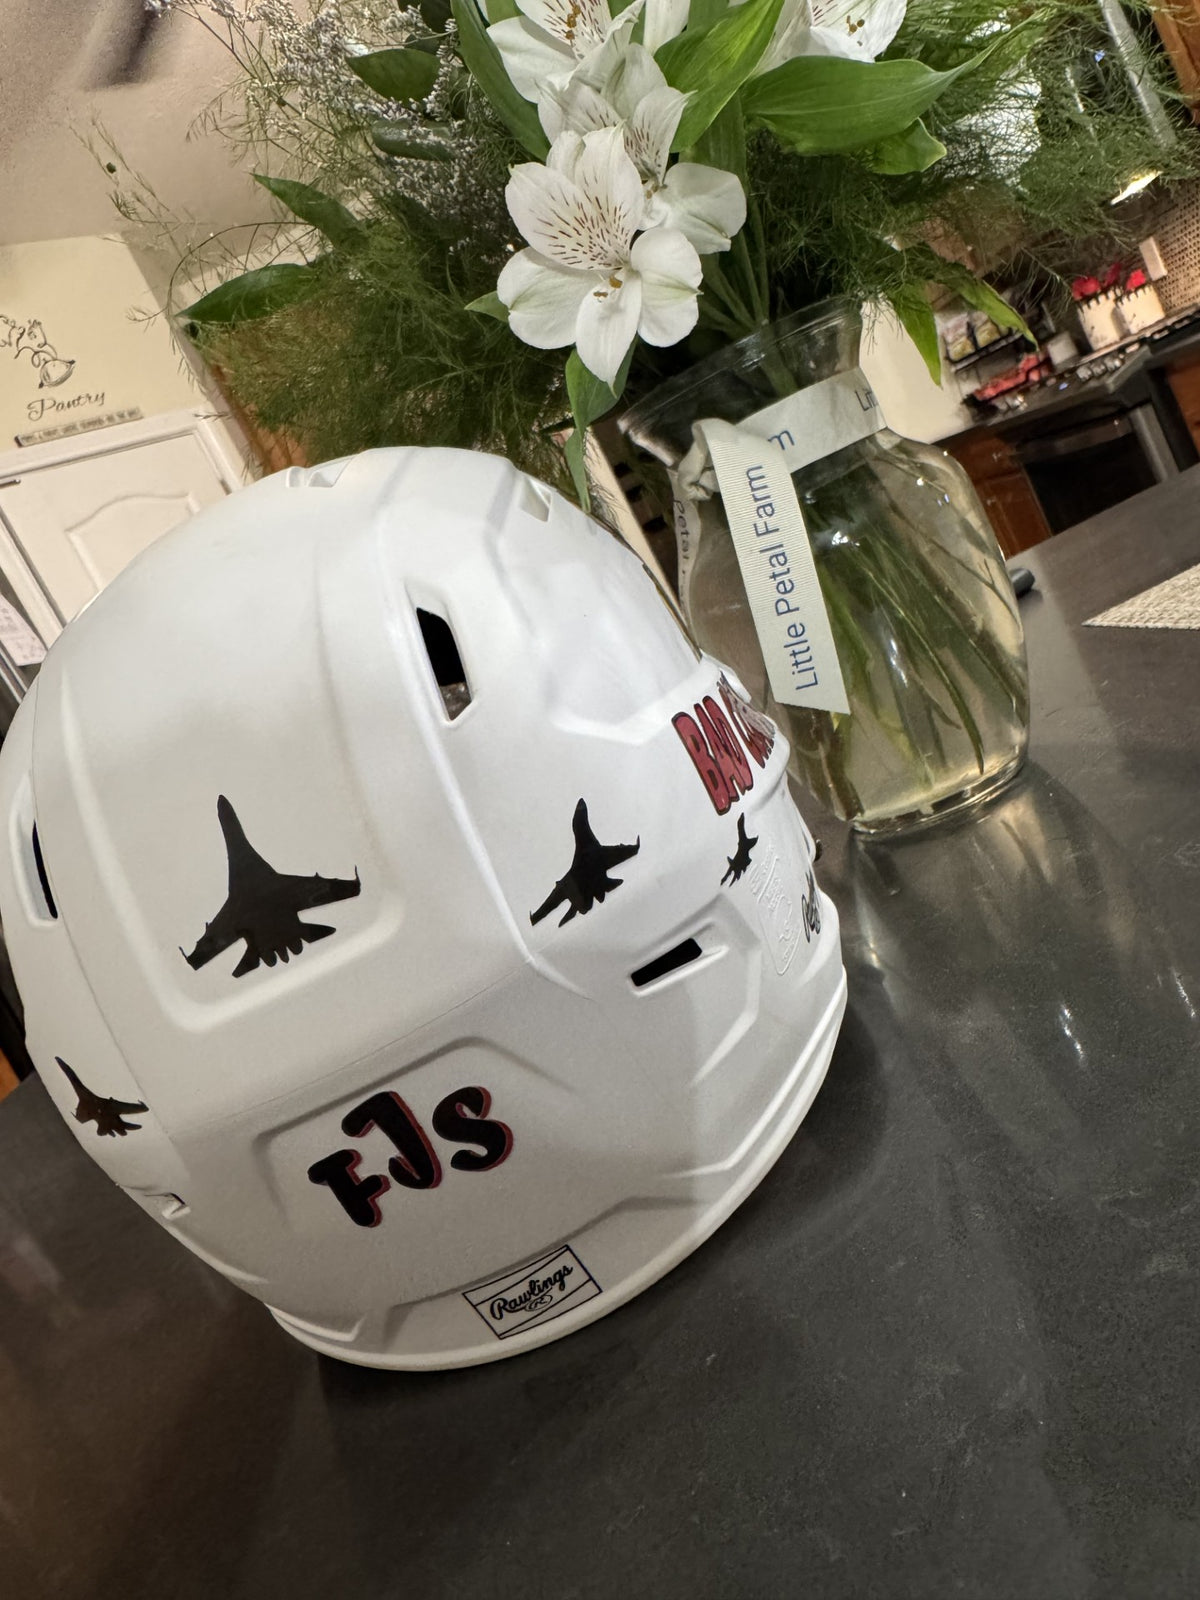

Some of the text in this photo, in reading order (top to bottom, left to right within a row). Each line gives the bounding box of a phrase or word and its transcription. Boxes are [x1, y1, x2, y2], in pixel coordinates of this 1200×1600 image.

[27, 391, 105, 421] Pantry
[744, 464, 819, 690] Little Petal Farm
[671, 695, 753, 816] BAD
[307, 1086, 514, 1228] FJS
[489, 1264, 573, 1320] Rawlings
